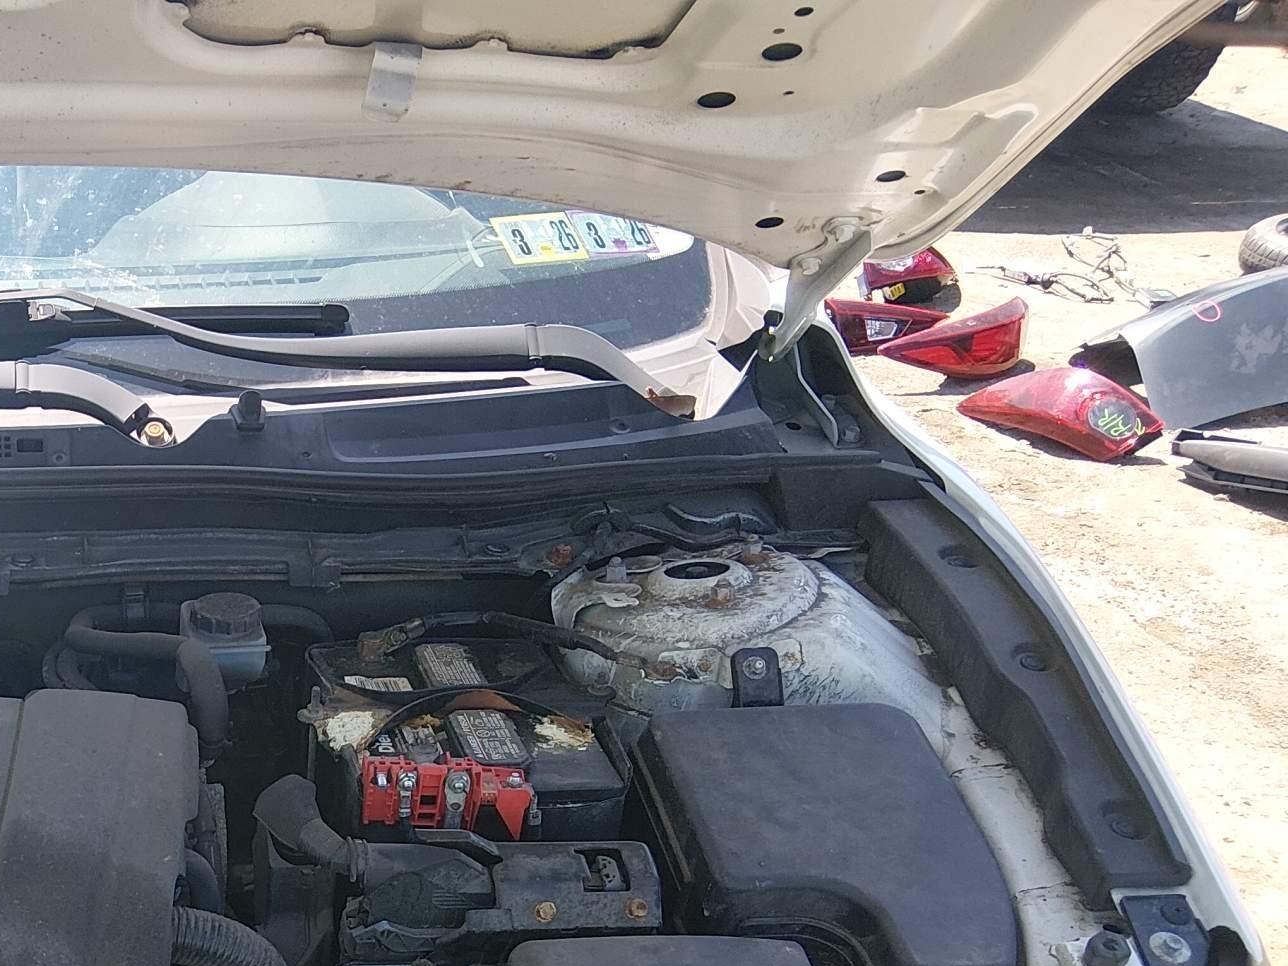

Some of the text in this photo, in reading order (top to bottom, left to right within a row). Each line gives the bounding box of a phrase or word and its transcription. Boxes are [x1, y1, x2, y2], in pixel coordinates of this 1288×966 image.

[512, 219, 580, 256] 3 26
[586, 222, 607, 249] 3
